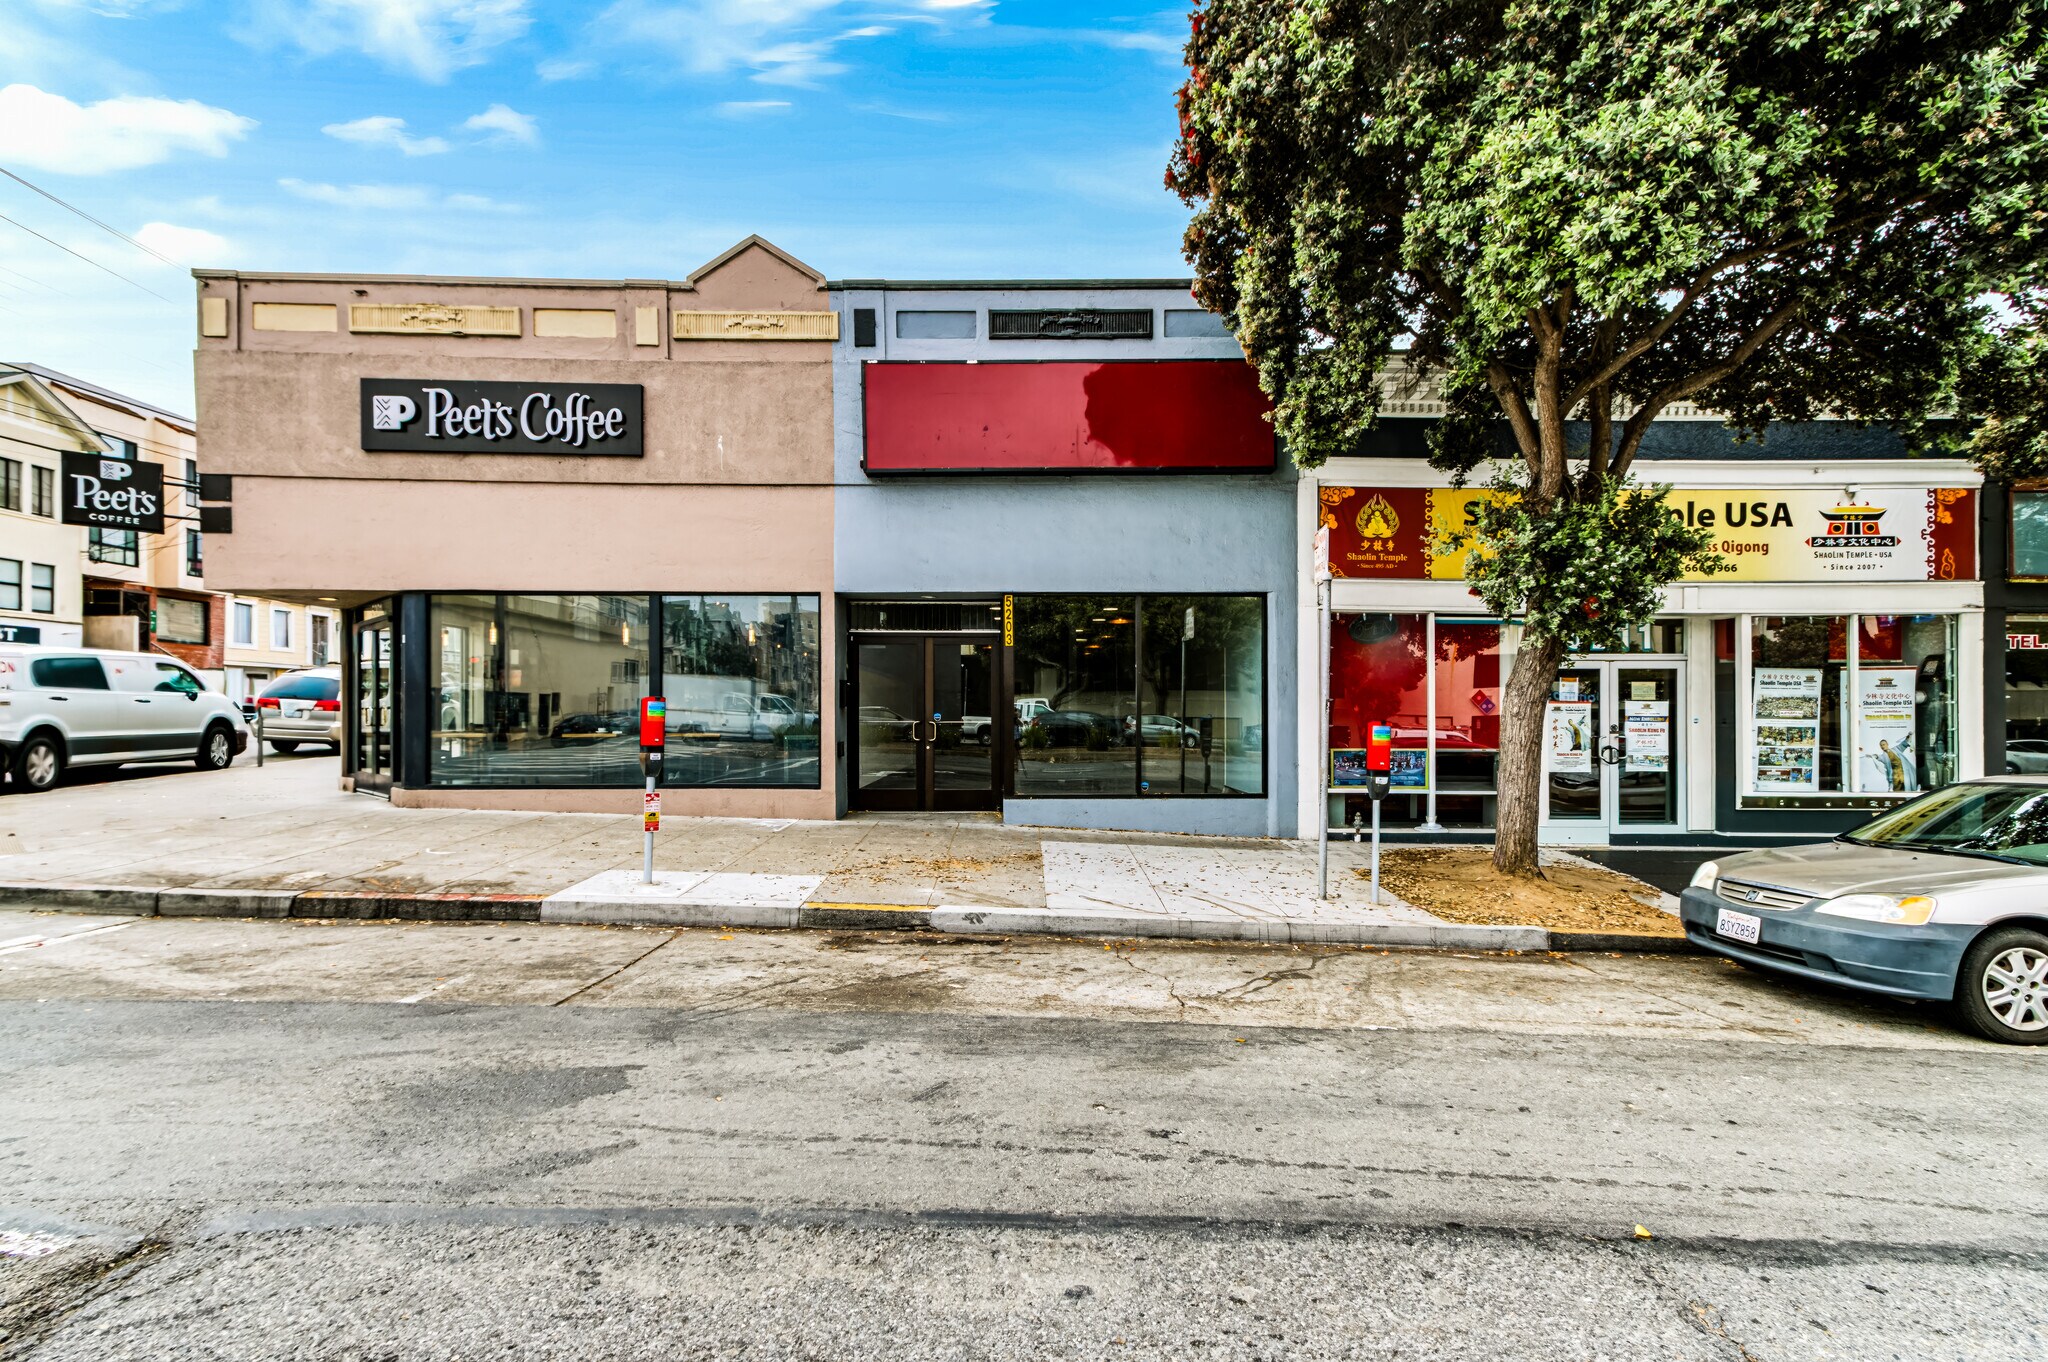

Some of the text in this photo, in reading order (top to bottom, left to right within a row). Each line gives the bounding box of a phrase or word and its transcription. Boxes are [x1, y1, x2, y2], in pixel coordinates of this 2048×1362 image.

[422, 388, 623, 447] Peet's Coffee
[70, 474, 156, 516] Peet's
[88, 513, 140, 525] COFFEE
[1725, 502, 1794, 528] USA
[1360, 539, 1395, 551] 少林寺
[1721, 541, 1769, 555] Qigong
[1813, 537, 1894, 547] 少林寺文化中心
[1379, 553, 1408, 563] Temple
[1720, 918, 1757, 939] 8SYZ858
